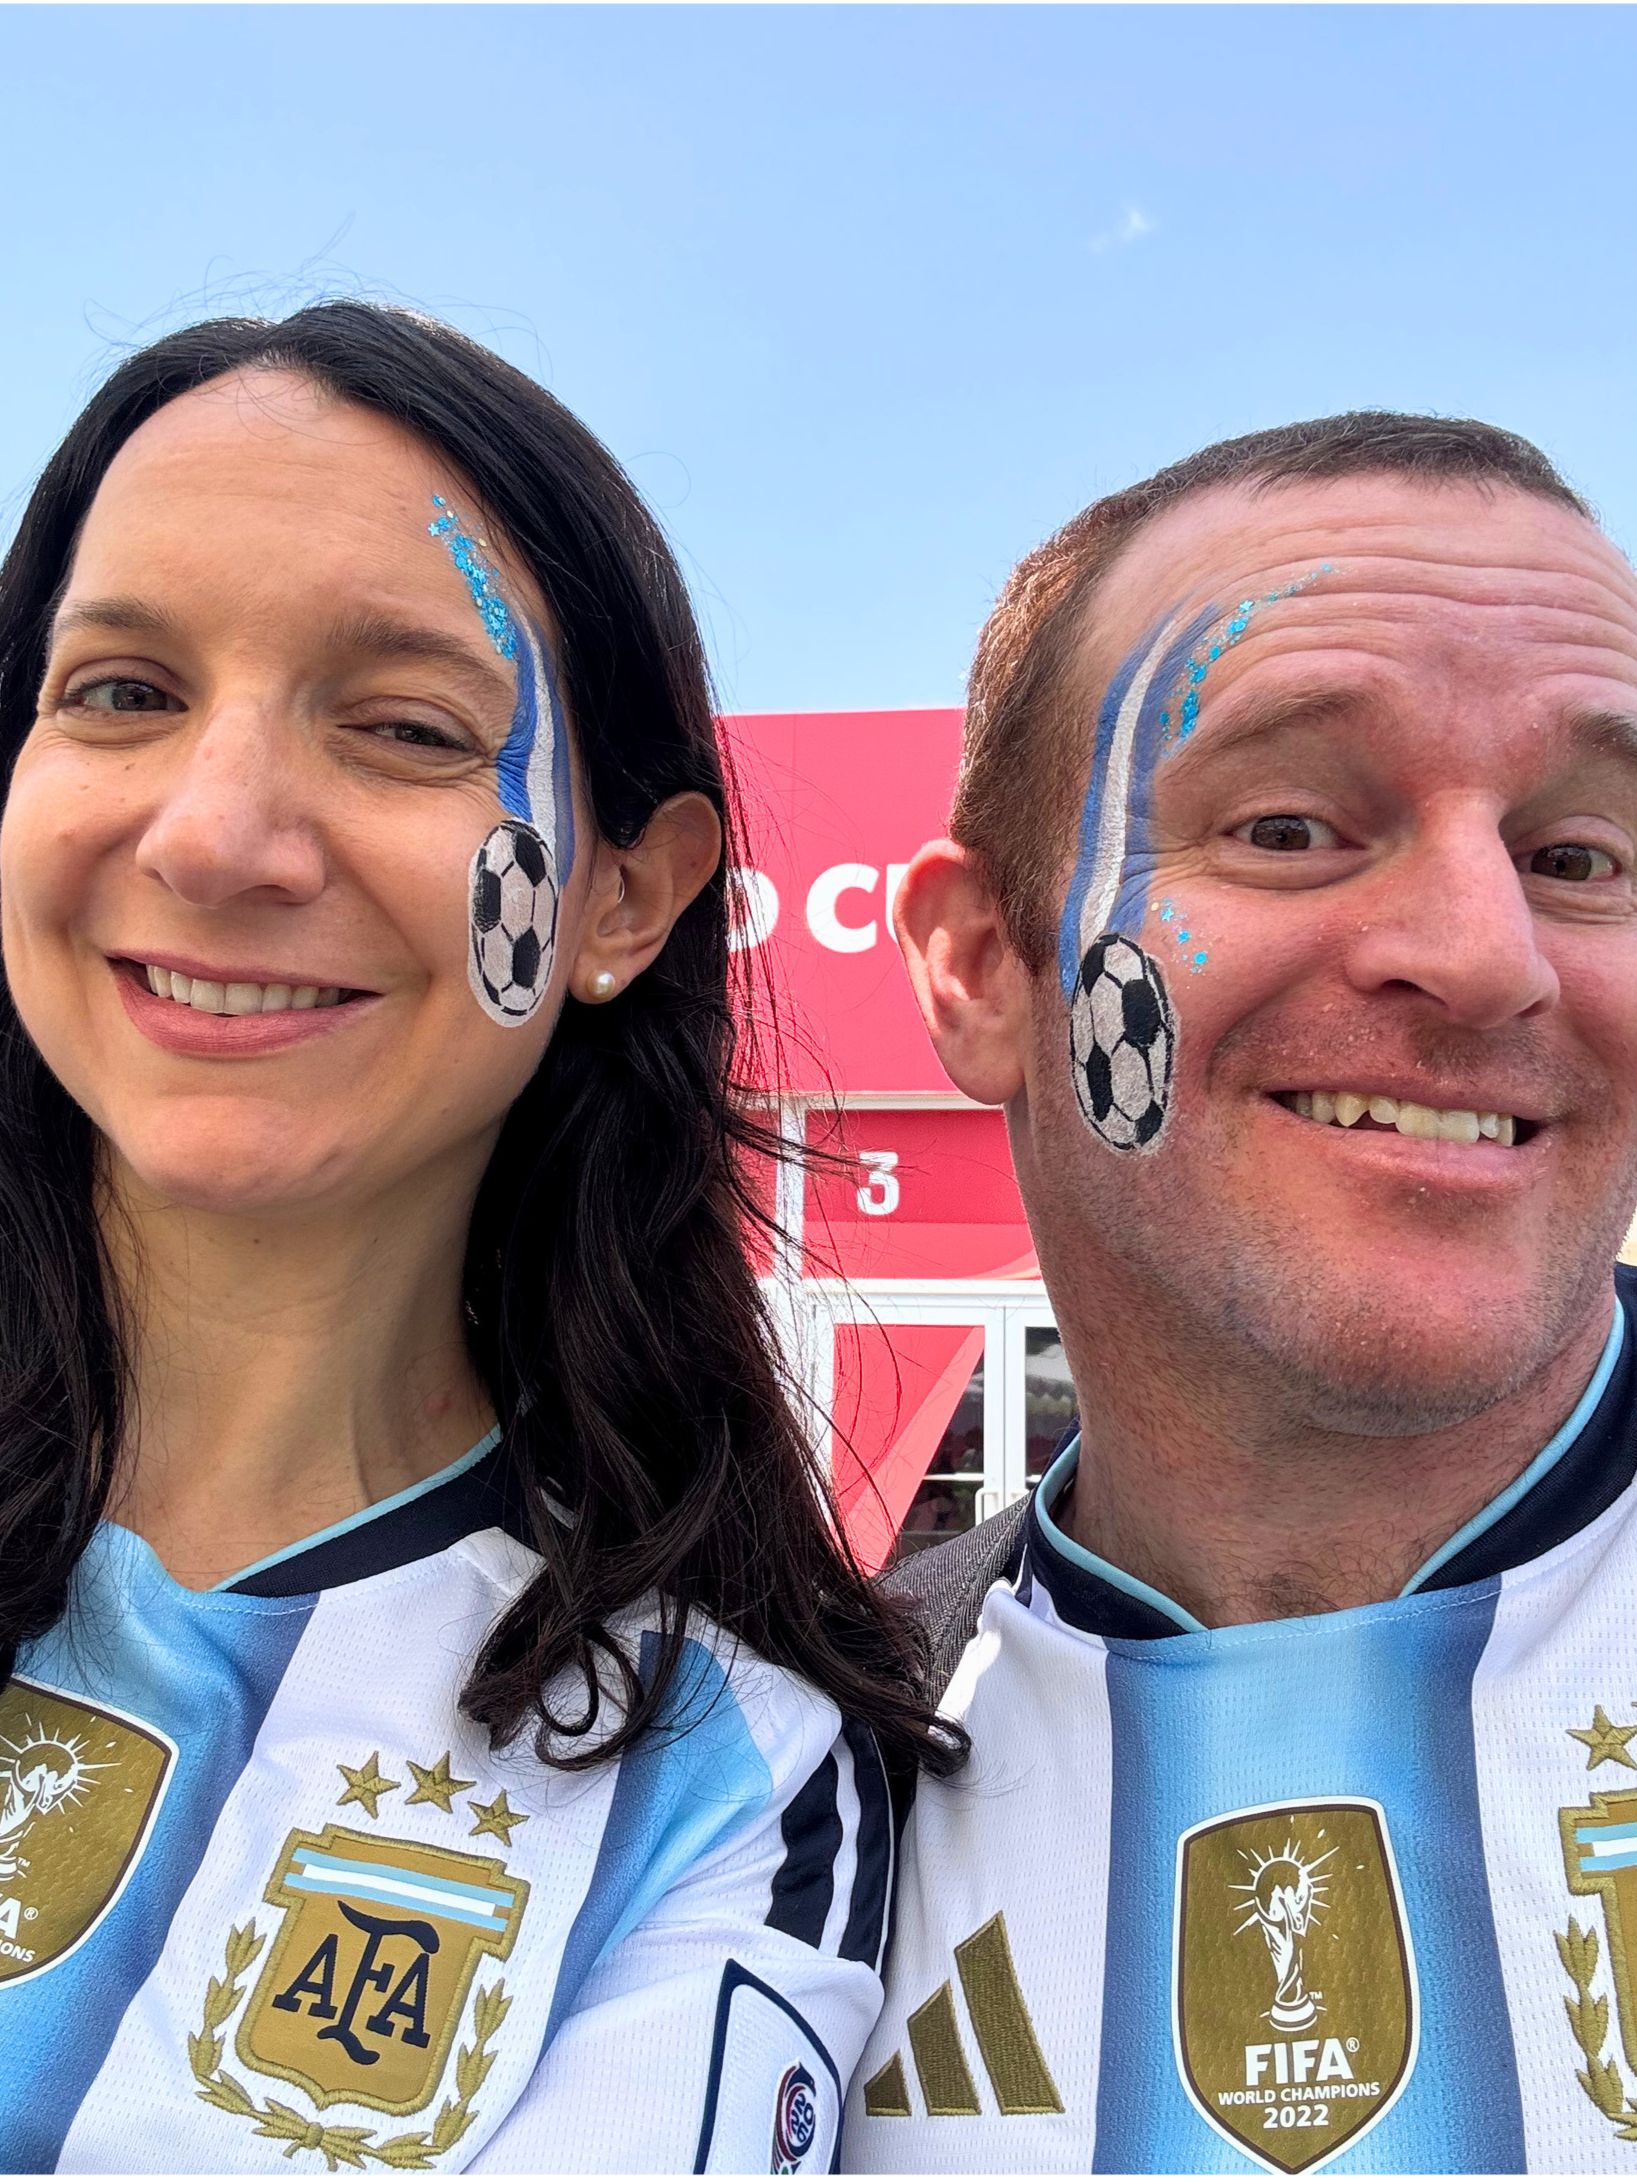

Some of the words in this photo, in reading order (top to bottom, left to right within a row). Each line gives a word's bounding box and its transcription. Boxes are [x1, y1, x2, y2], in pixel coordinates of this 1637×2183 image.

[806, 863, 910, 953] C
[857, 1151, 900, 1216] 3
[271, 1900, 440, 2066] AFA
[1218, 2089, 1276, 2106] WORLD
[1280, 2082, 1381, 2102] CHAMPIONS
[1263, 2104, 1330, 2129] 2022
